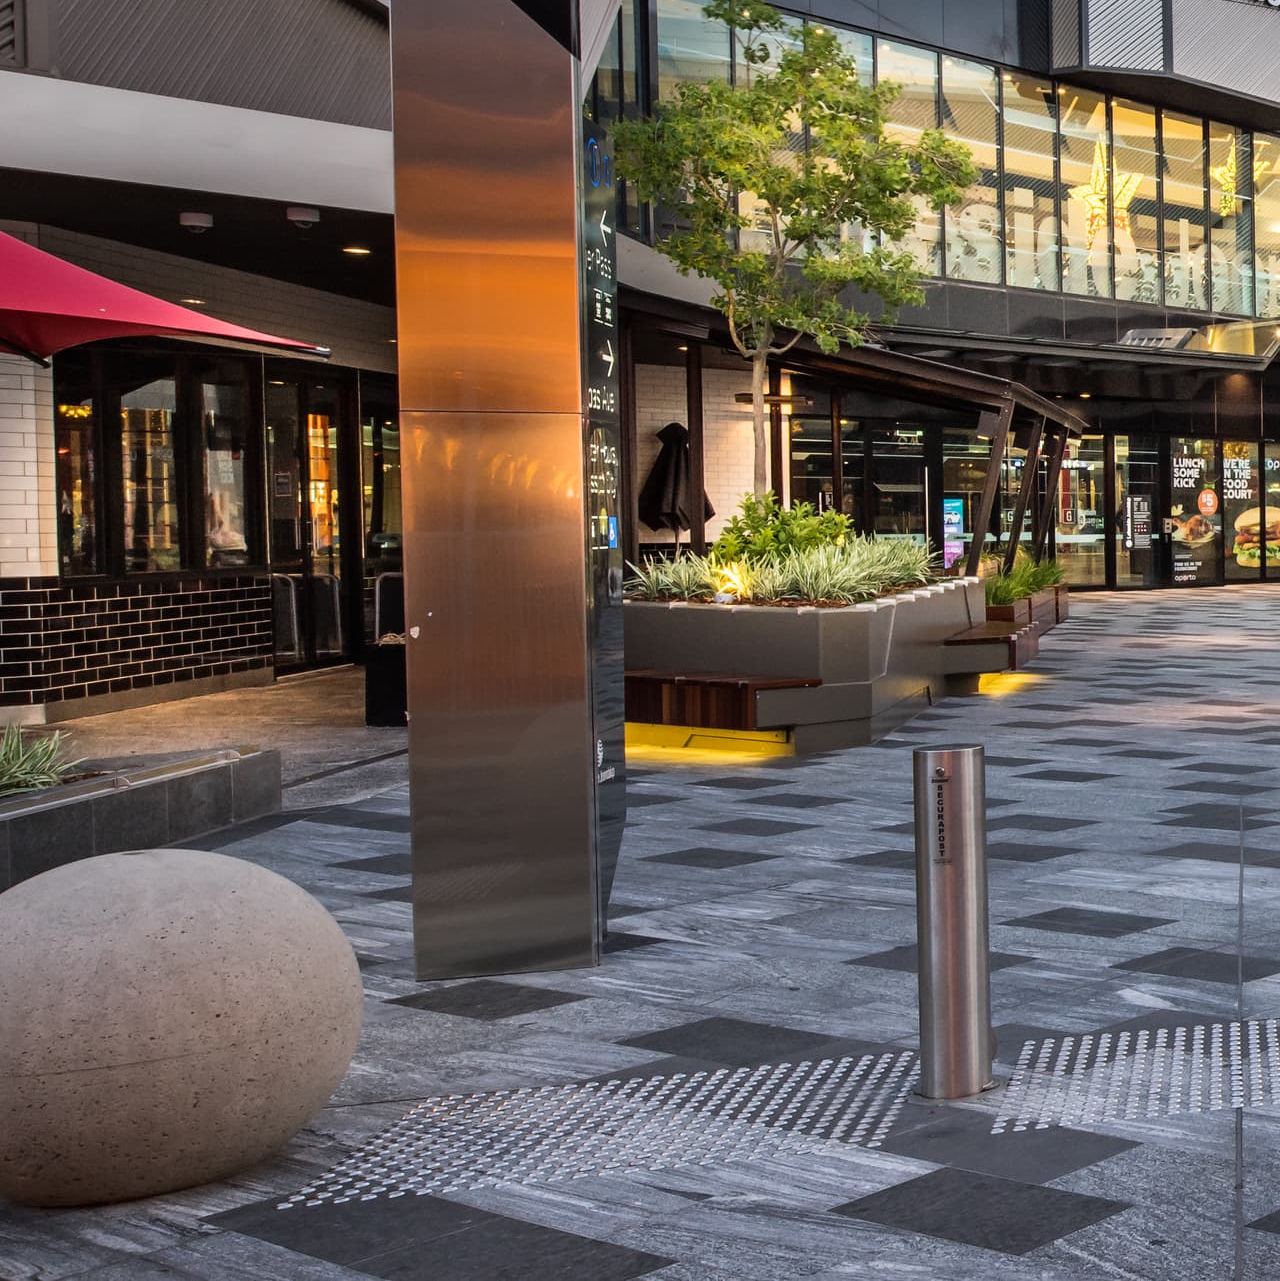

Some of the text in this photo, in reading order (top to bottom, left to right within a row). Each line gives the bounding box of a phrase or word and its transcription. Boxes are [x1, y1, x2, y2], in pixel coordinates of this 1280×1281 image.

[1173, 458, 1204, 468] LUNCH
[1173, 468, 1200, 478] SOME
[1233, 470, 1251, 479] THE
[1173, 479, 1196, 488] KICK
[937, 784, 945, 857] SECURAPOST
